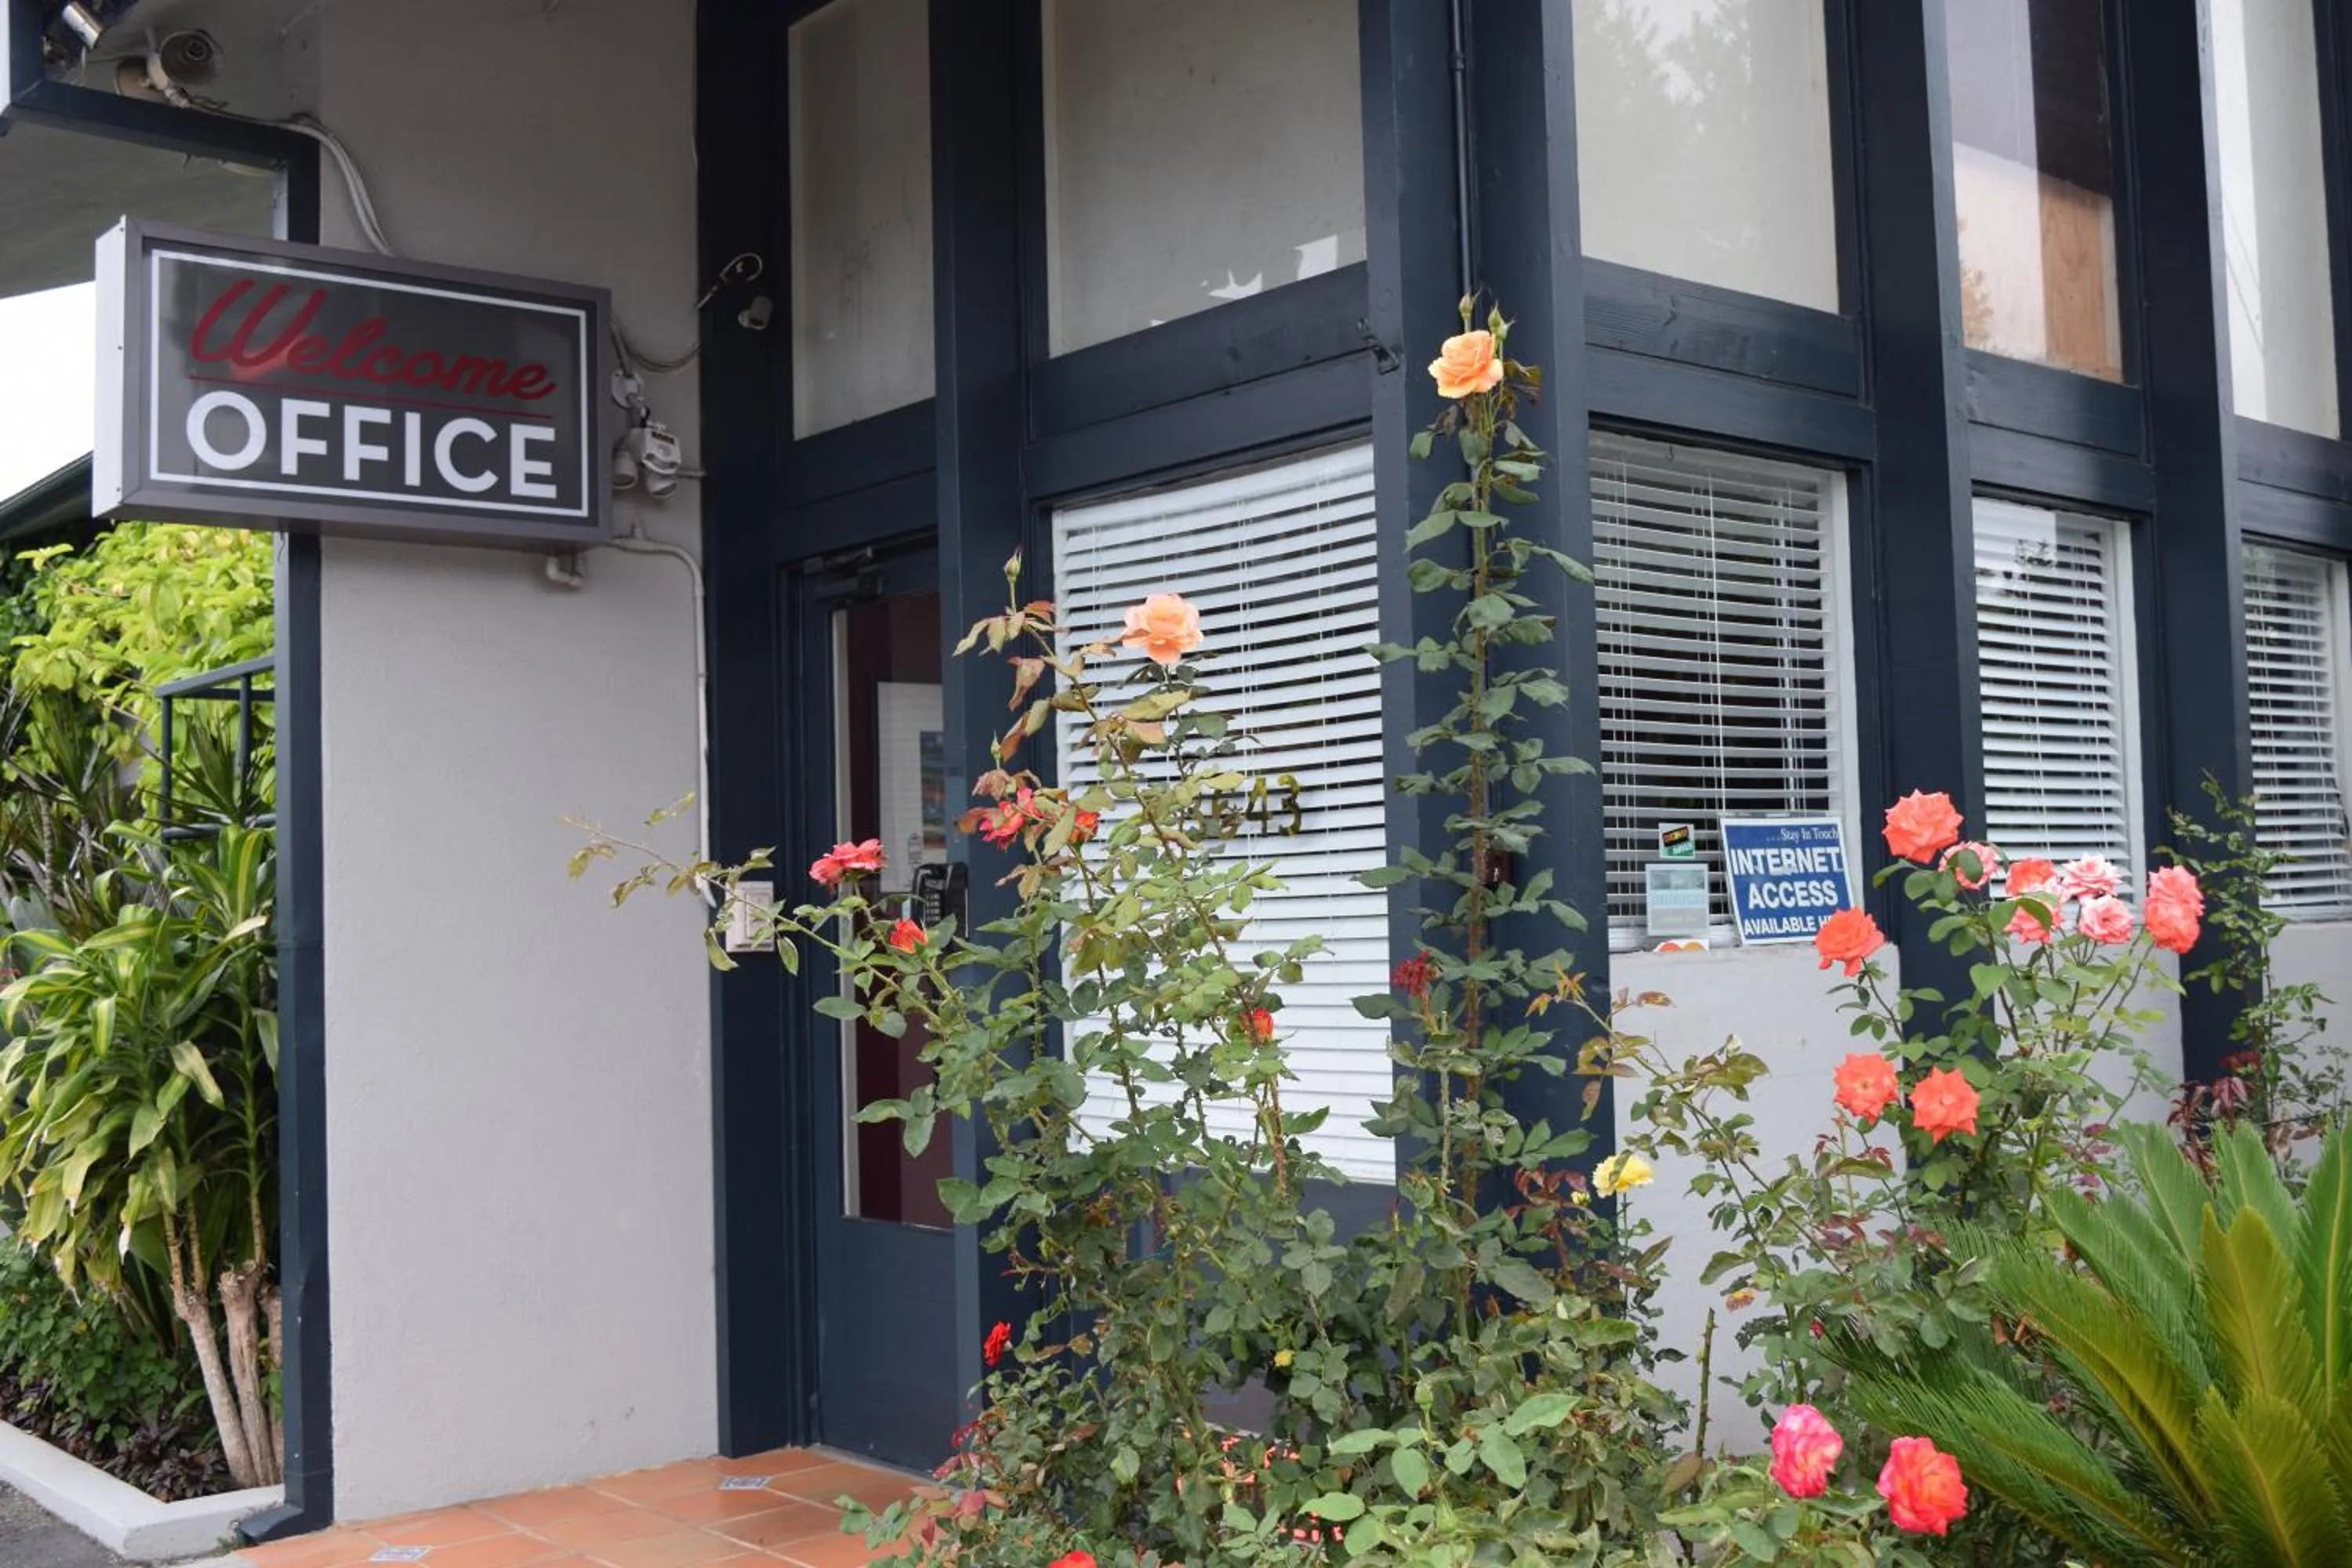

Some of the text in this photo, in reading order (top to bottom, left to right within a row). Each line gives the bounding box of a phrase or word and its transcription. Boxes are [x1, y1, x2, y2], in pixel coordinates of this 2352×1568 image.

[189, 278, 557, 401] Welcome
[186, 390, 557, 499] OFFICE
[1811, 826, 1839, 840] Touch
[1730, 847, 1841, 876] INTERNET
[1748, 879, 1838, 909] ACCESS
[1744, 916, 1817, 935] AVAILABLE
